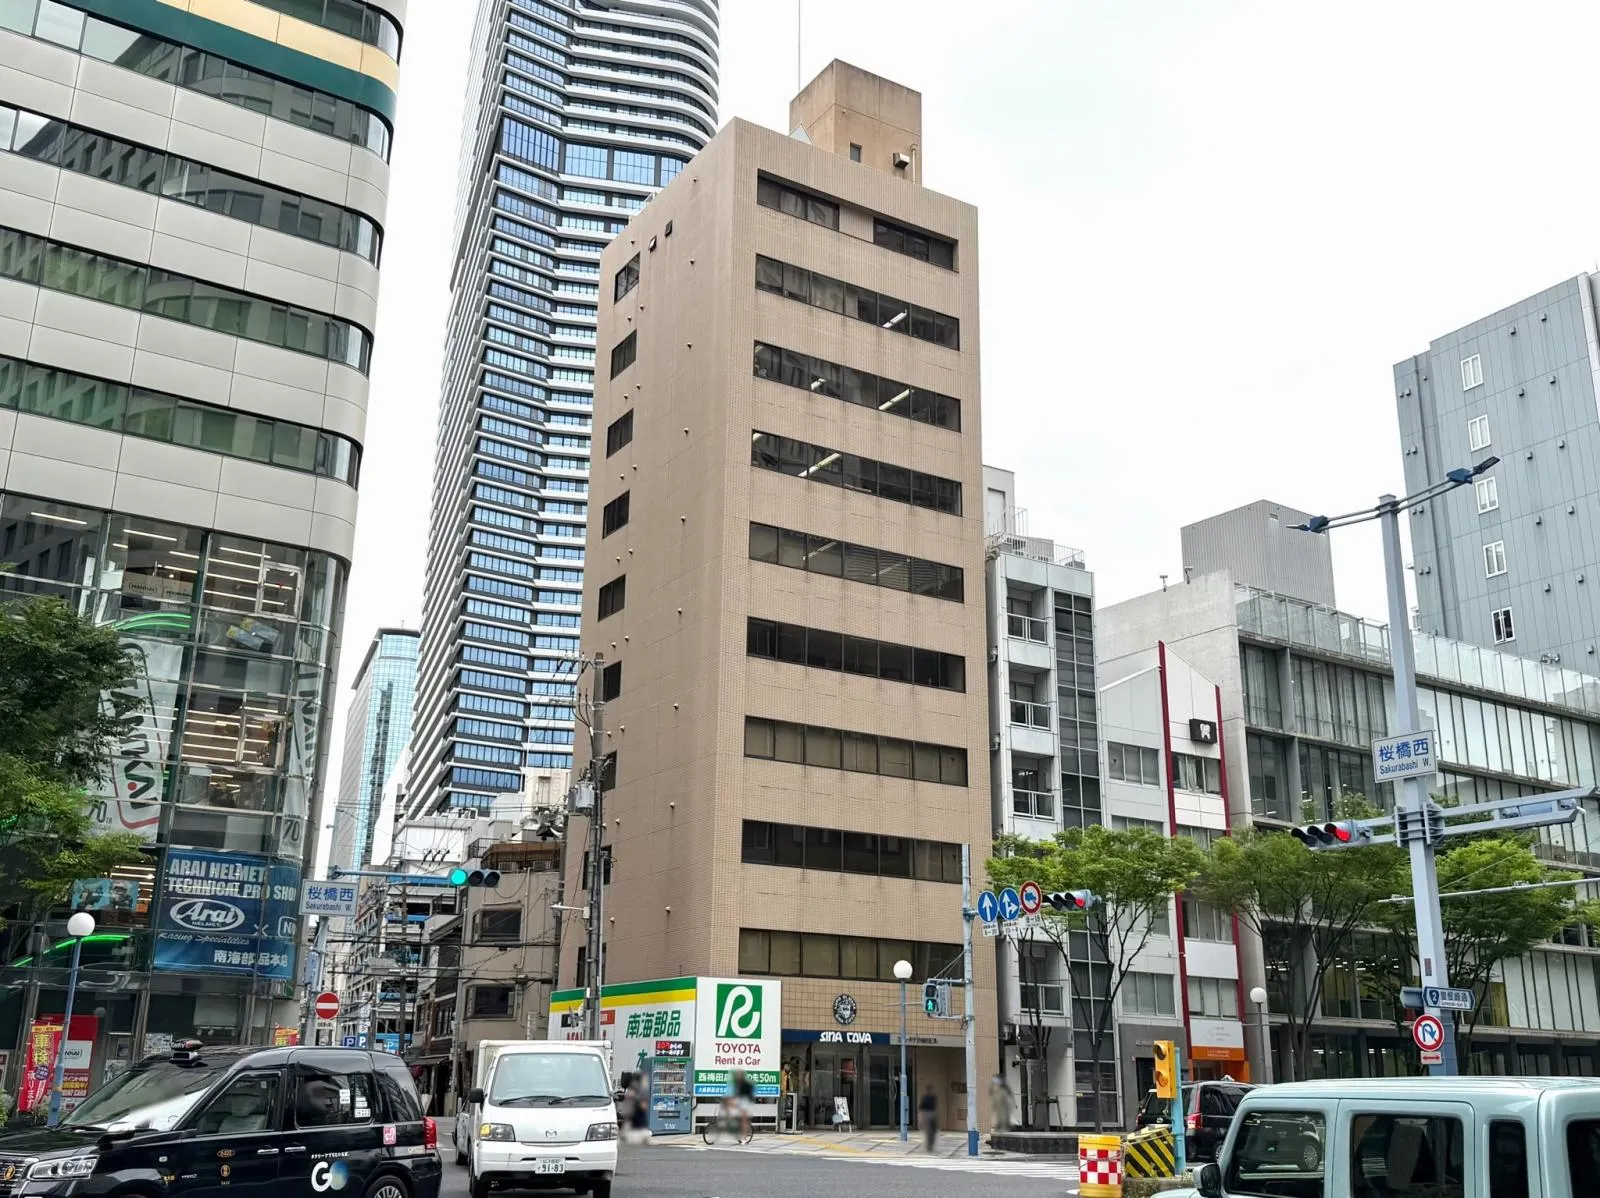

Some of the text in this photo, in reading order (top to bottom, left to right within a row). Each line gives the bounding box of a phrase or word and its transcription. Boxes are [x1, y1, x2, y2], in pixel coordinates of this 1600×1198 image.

[1379, 738, 1429, 762] 桜橋西
[1380, 760, 1418, 775] Sakurabashi
[282, 821, 300, 841] 70
[169, 858, 267, 882] ARAI HELMET
[167, 877, 240, 897] TECHNICAL
[243, 883, 271, 899] PRO
[307, 886, 354, 902] 桜橋西
[176, 902, 237, 924] Arai
[305, 901, 342, 911] Sakurabashi
[191, 920, 220, 928] HELMET
[213, 949, 289, 967] 南海部品本店
[1431, 992, 1437, 1001] 2
[626, 1010, 681, 1038] 南海部品
[347, 1038, 354, 1047] P
[819, 1031, 872, 1044] SINA COVA
[715, 1043, 761, 1054] TOYOTA
[715, 1055, 735, 1065] Rent
[745, 1056, 761, 1066] Car
[542, 1164, 564, 1172] 91-83
[311, 1161, 349, 1193] GO
